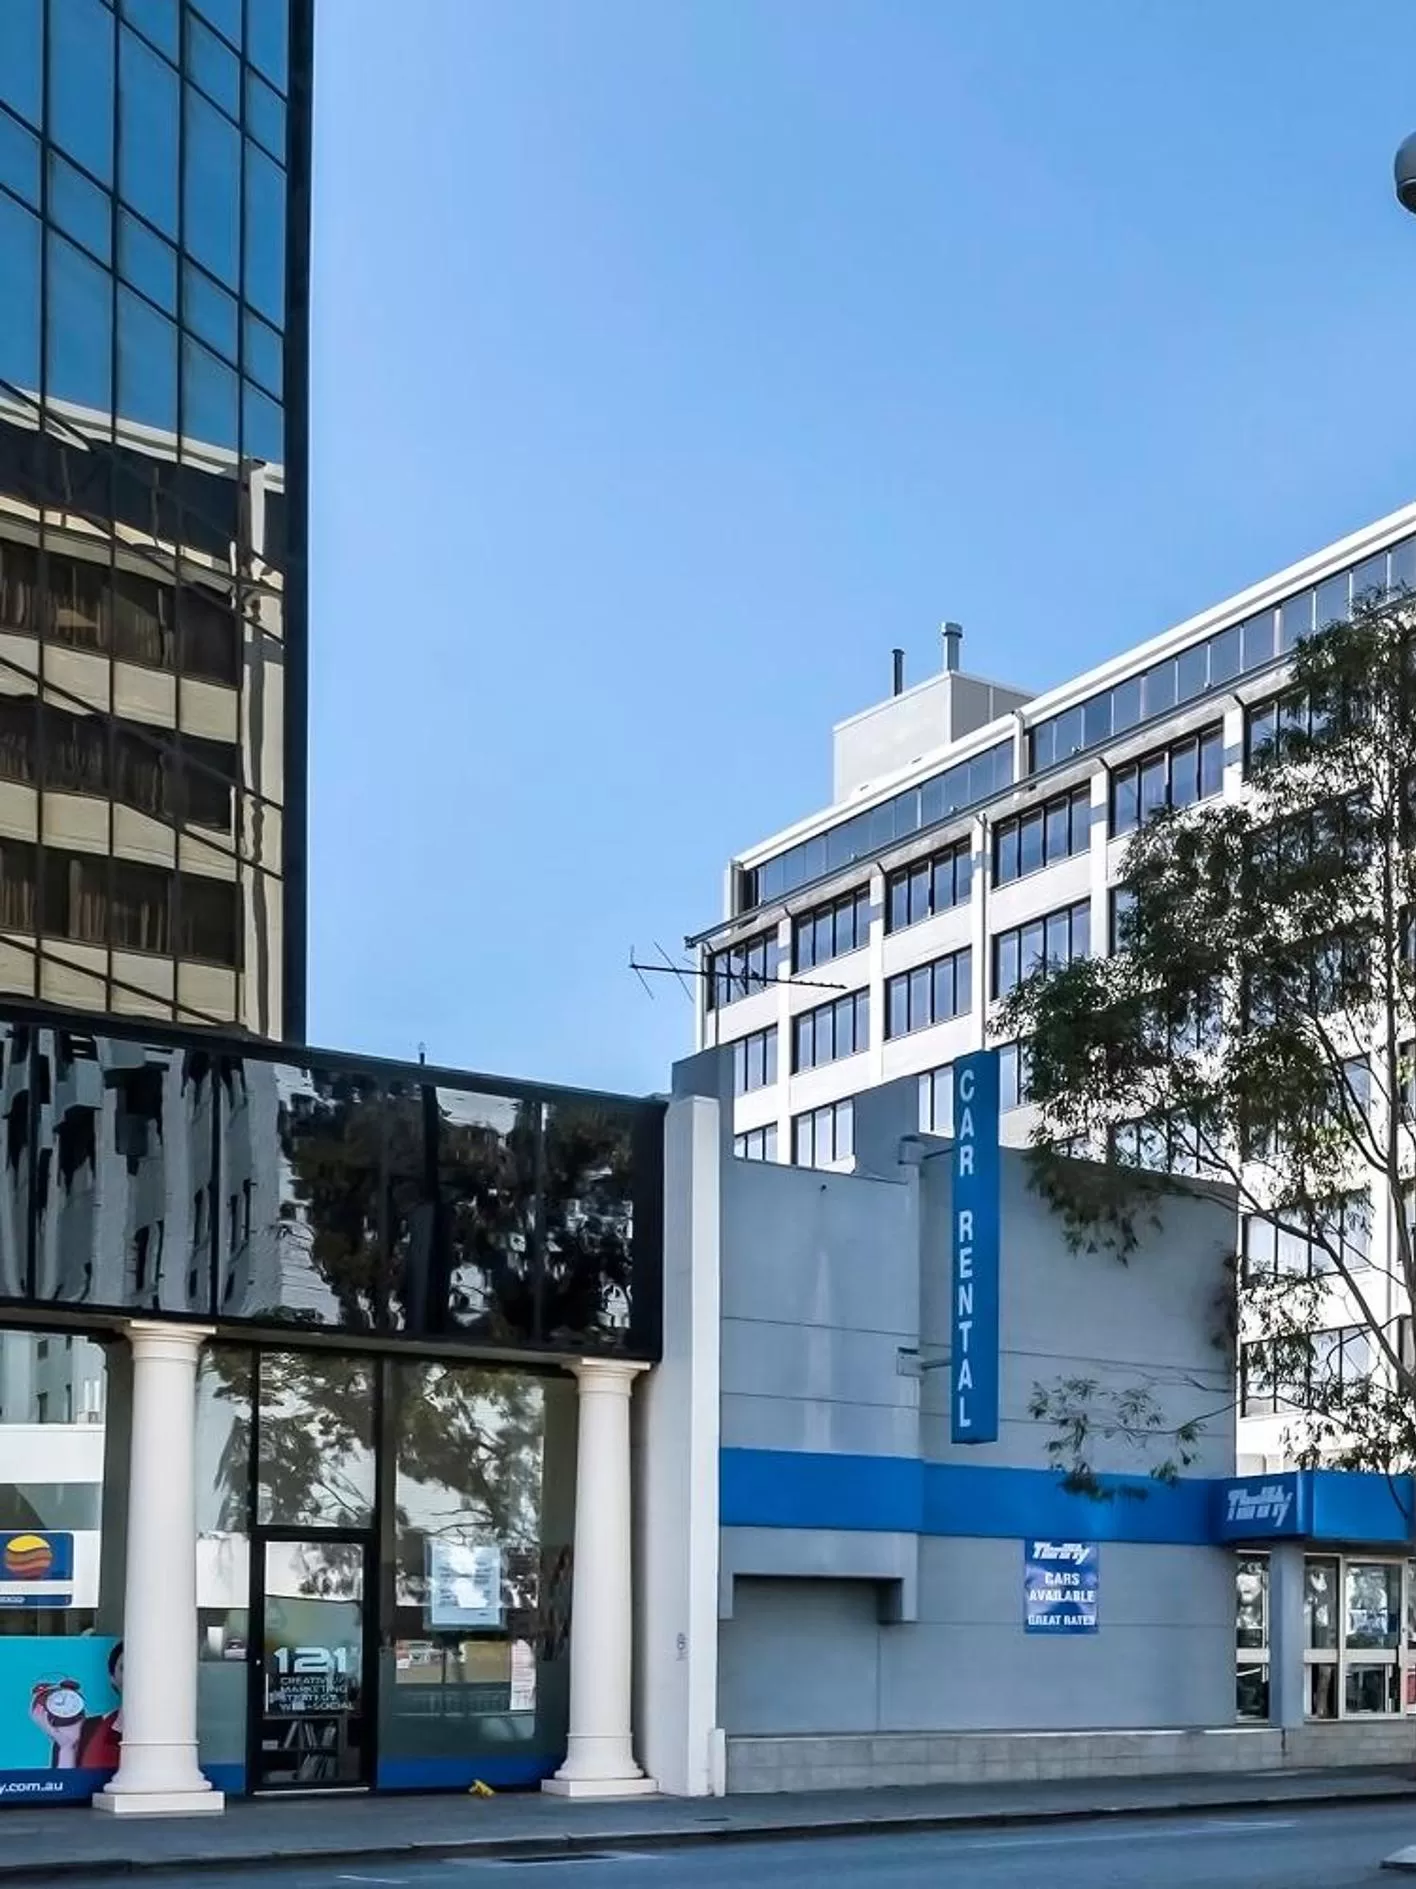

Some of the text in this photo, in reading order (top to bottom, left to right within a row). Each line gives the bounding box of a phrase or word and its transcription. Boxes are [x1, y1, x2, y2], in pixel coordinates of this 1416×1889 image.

[958, 1069, 975, 1429] CAR RENTAL
[1226, 1484, 1294, 1528] Thrifty
[1032, 1541, 1091, 1565] Thrifty
[1045, 1572, 1080, 1586] CARS
[1029, 1589, 1096, 1602] AVAILABLE
[1028, 1614, 1096, 1625] GREAT RATES
[274, 1647, 347, 1673] 121
